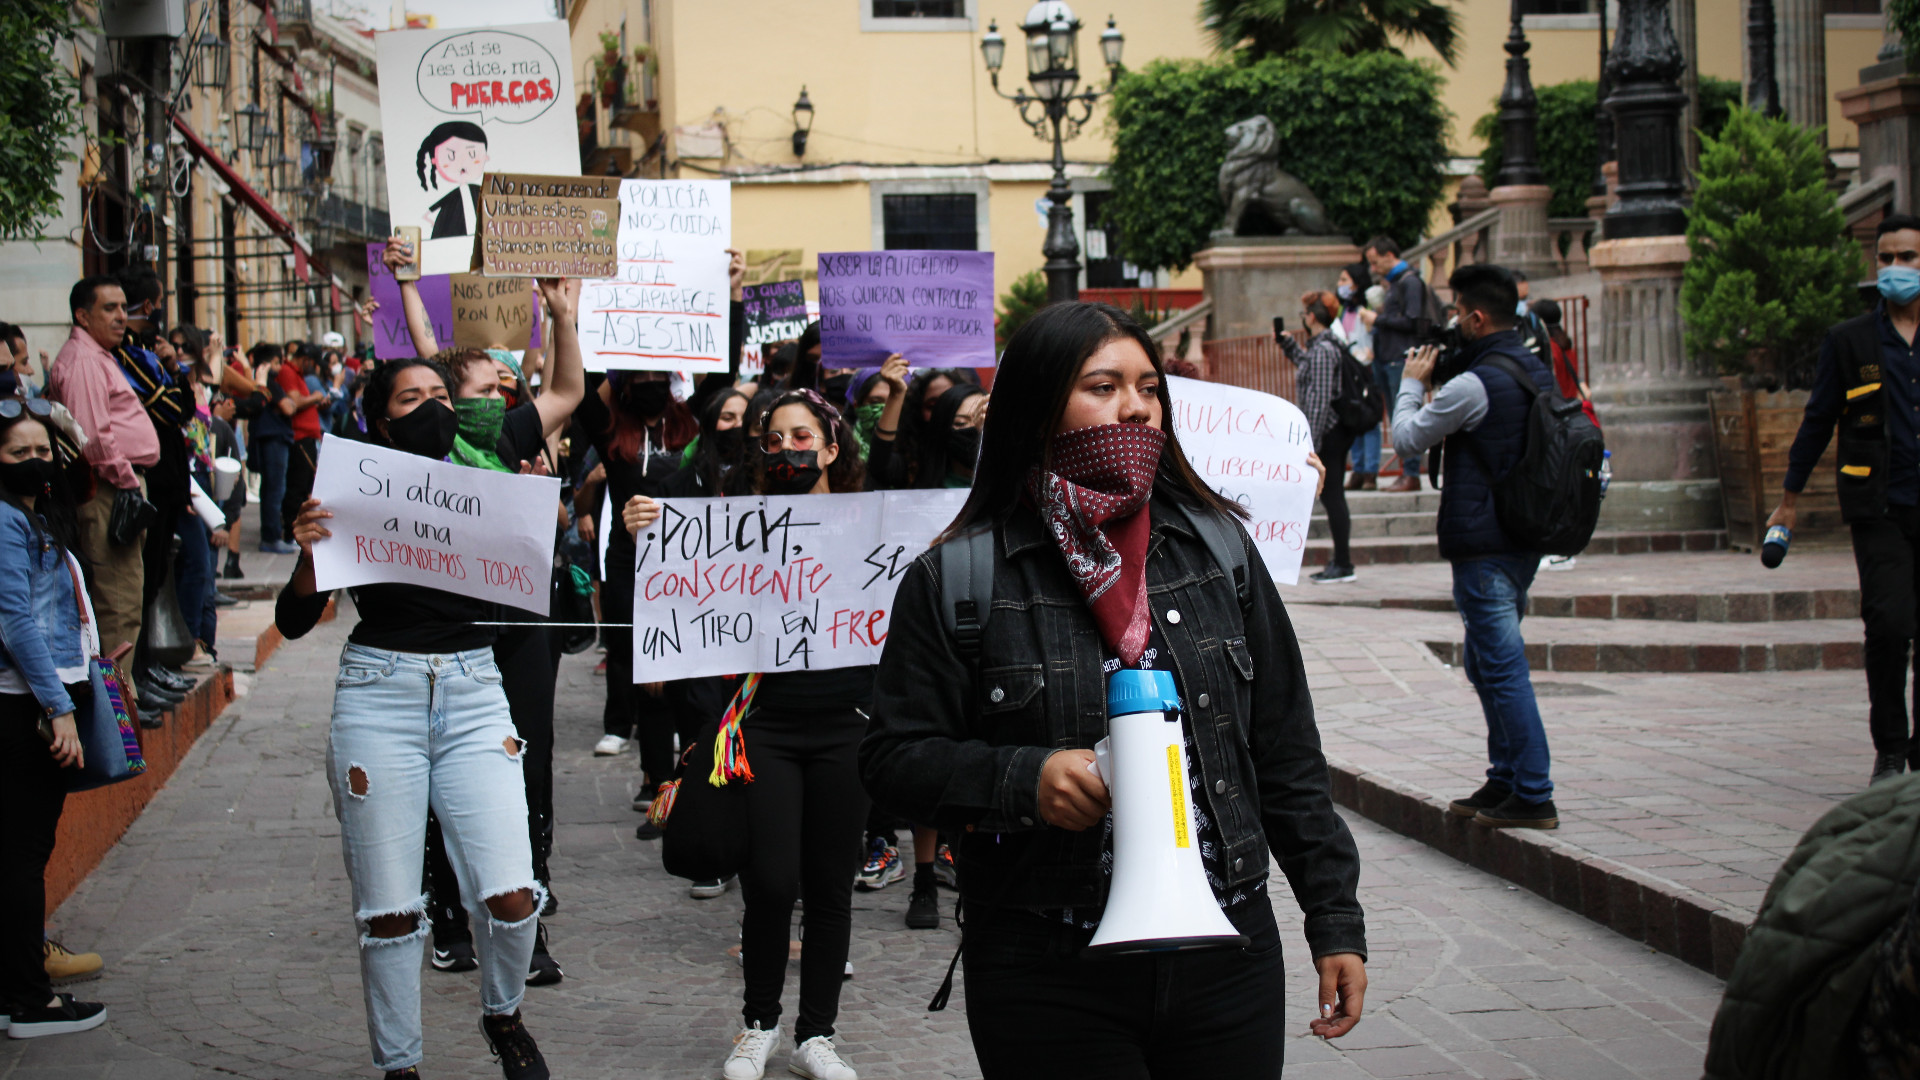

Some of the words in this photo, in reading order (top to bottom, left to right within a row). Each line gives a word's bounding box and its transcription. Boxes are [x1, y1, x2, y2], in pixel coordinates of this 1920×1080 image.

[441, 41, 475, 59] Así
[481, 43, 501, 56] se
[511, 60, 541, 75] ma
[450, 77, 554, 110] PUERCOS
[491, 175, 515, 196] No
[520, 181, 544, 197] nos
[547, 183, 593, 198] acusen
[595, 179, 609, 198] de
[543, 198, 568, 218] esto
[570, 204, 587, 219] es
[628, 212, 666, 232] NOS
[670, 213, 723, 236] CUIDA
[486, 237, 532, 255] estamos
[534, 241, 549, 254] en
[552, 238, 613, 256] resistencia
[622, 239, 666, 262] OSA
[508, 259, 523, 272] no
[525, 259, 559, 274] somos
[820, 256, 835, 277] X
[836, 255, 862, 276] SER
[885, 255, 959, 277] AUTORIDAD
[454, 282, 483, 300] NOS
[760, 280, 802, 297] QUIERO
[820, 285, 846, 307] NOS
[852, 285, 905, 305] QUIEREN
[912, 287, 978, 310] CONTROLAR
[457, 306, 488, 321] RON
[496, 304, 528, 329] ALAS
[820, 314, 845, 332] CON
[857, 314, 872, 332] SU
[885, 314, 927, 332] ABUSO
[947, 317, 985, 336] PODER
[358, 458, 390, 498] Si
[406, 473, 481, 517] atacan
[384, 517, 399, 533] a
[414, 520, 451, 546] una
[1255, 519, 1303, 551] ORES
[355, 535, 467, 580] RESPONDEMOS
[476, 557, 534, 596] TODAS
[690, 608, 752, 649] TIRO
[781, 598, 819, 635] EN
[642, 608, 681, 661] UN
[775, 636, 814, 669] LA
